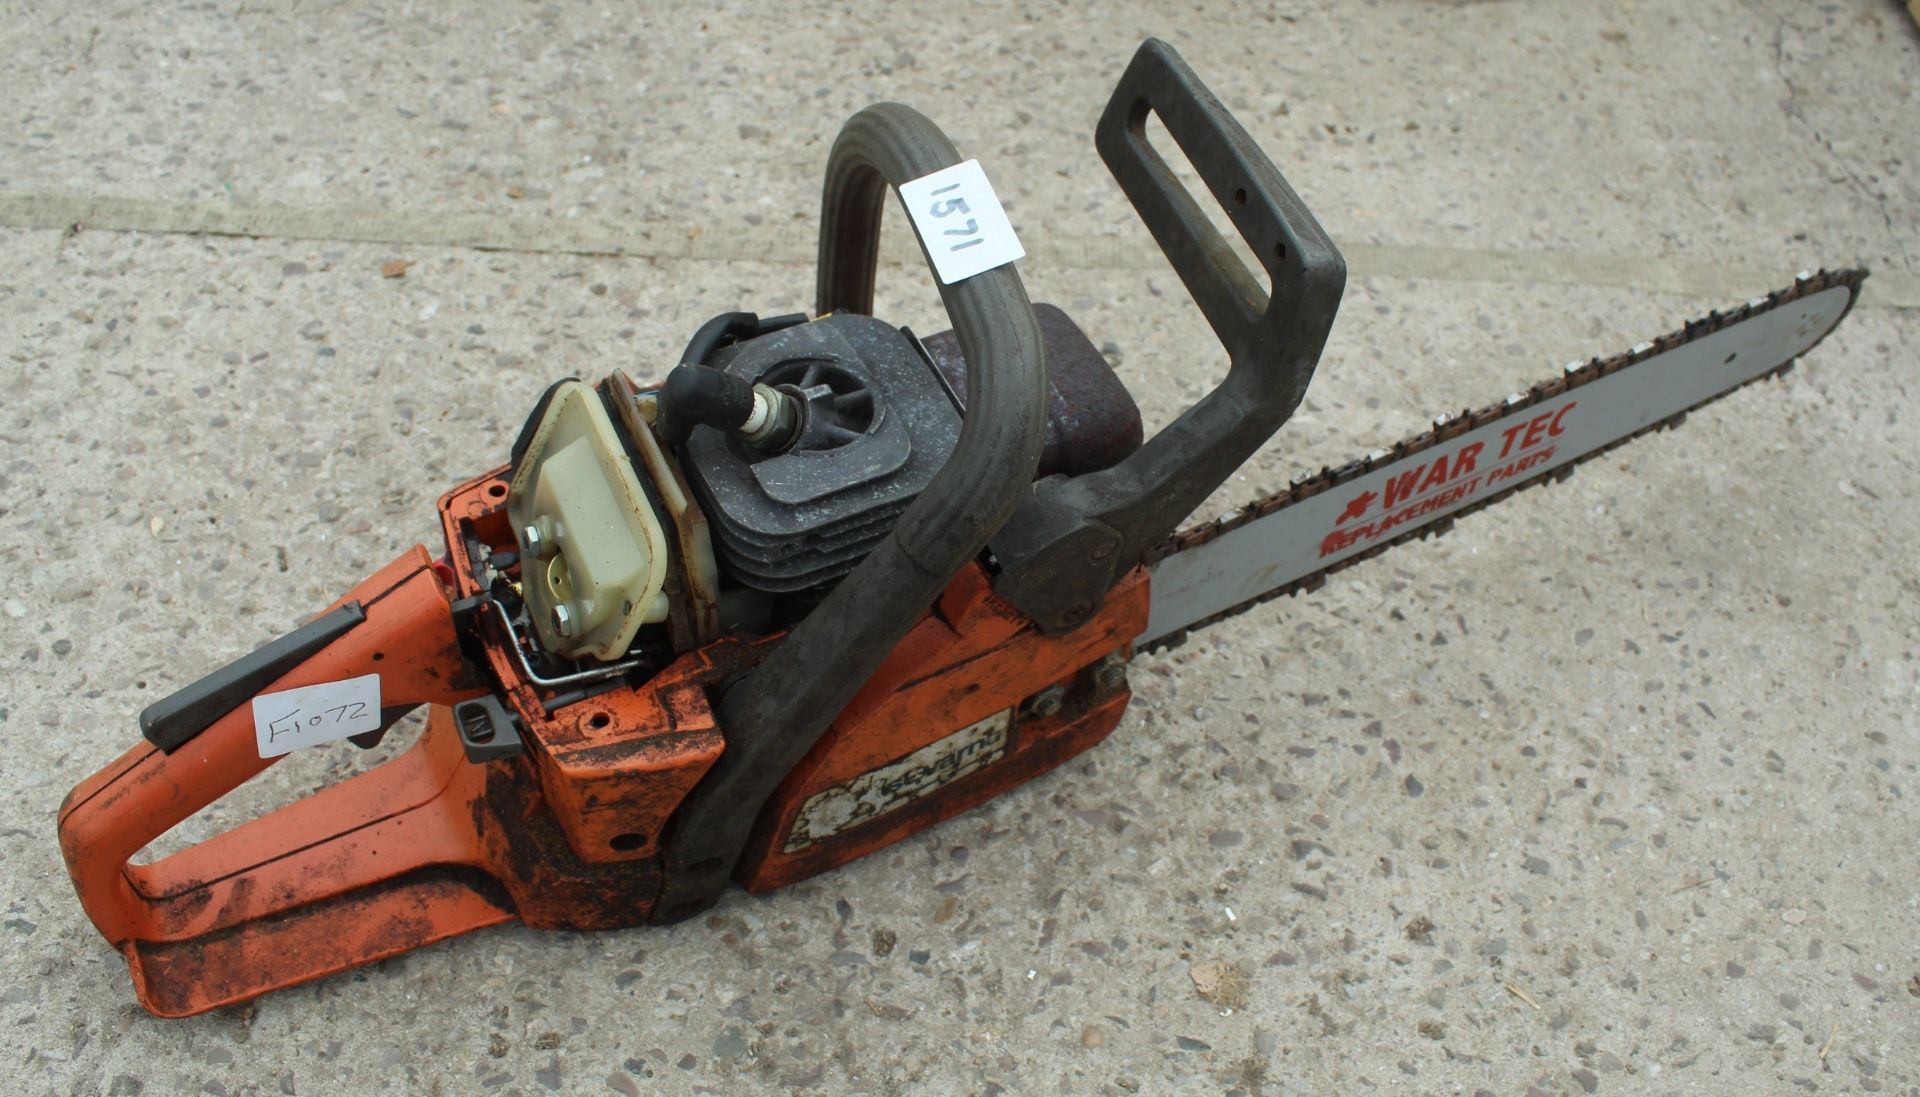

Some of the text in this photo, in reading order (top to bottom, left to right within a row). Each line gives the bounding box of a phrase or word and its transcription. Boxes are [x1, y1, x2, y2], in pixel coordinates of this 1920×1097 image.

[930, 183, 984, 252] 1571
[1319, 445, 1557, 559] REPLACEMENT PARTS
[1383, 403, 1577, 509] WAR TEC
